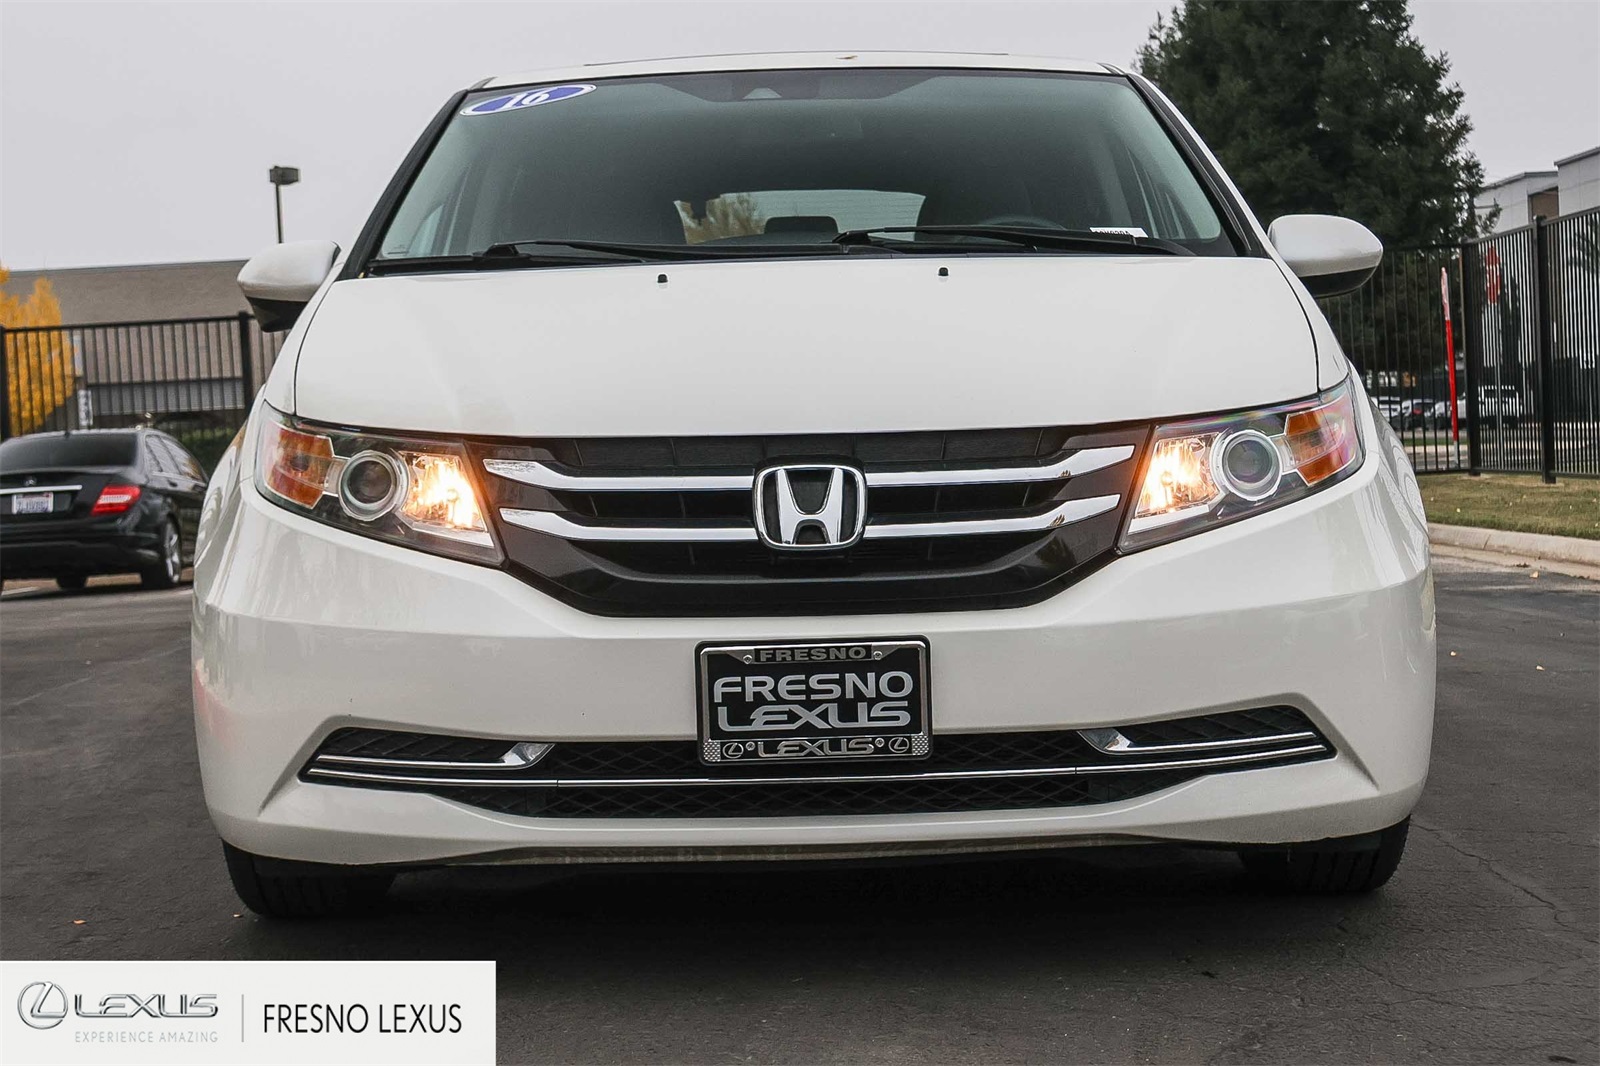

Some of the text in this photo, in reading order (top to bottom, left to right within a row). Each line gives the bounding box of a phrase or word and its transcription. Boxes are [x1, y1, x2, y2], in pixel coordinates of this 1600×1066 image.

[499, 87, 557, 109] 16
[759, 646, 867, 662] FRESNO
[713, 670, 914, 703] FRESNO
[717, 700, 912, 732] LEXUS
[757, 737, 875, 758] LEXUS
